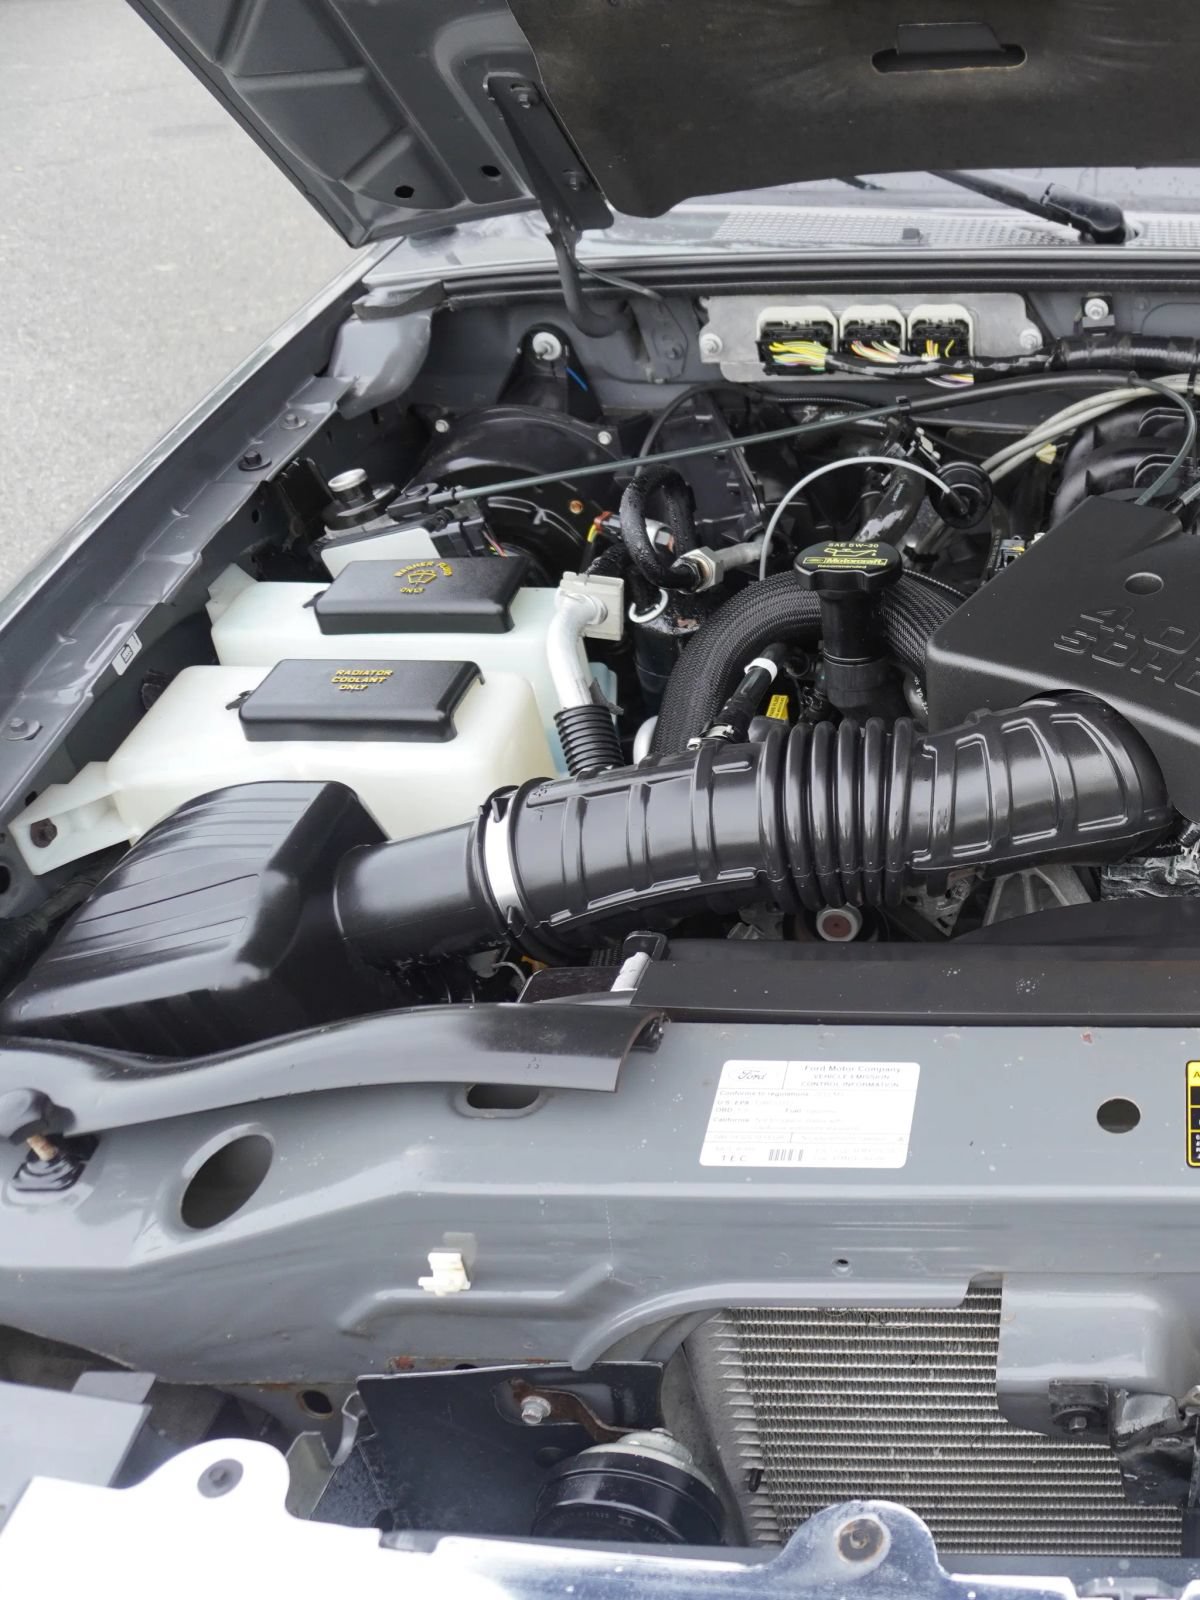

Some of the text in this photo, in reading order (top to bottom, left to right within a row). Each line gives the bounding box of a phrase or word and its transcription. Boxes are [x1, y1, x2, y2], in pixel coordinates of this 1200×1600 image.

[827, 557, 884, 566] Motorcraft
[336, 669, 394, 677] RADIATOR
[331, 676, 387, 684] COOLANT
[737, 1069, 768, 1081] Ford
[804, 1065, 901, 1076] Ford Motor Company
